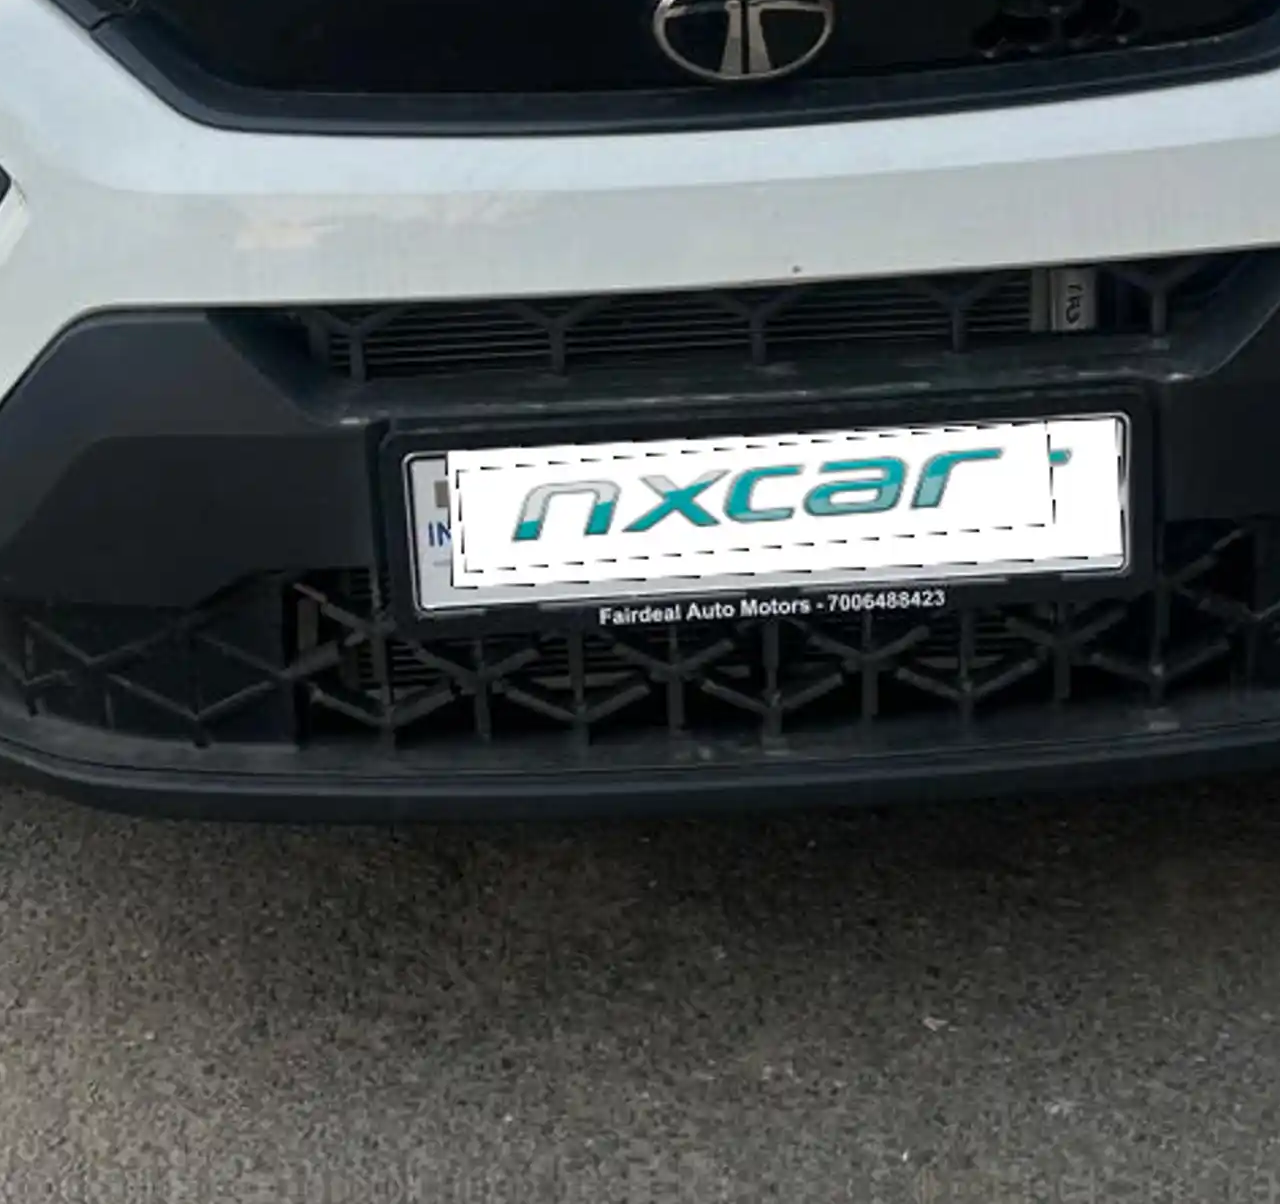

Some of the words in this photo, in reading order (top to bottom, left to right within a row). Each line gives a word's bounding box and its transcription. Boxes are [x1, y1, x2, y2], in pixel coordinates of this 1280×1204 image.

[427, 521, 453, 547] IN
[599, 607, 682, 626] Fairdeal
[686, 602, 735, 622] Auto
[740, 597, 811, 618] Motors
[828, 589, 946, 613] 7006488423
